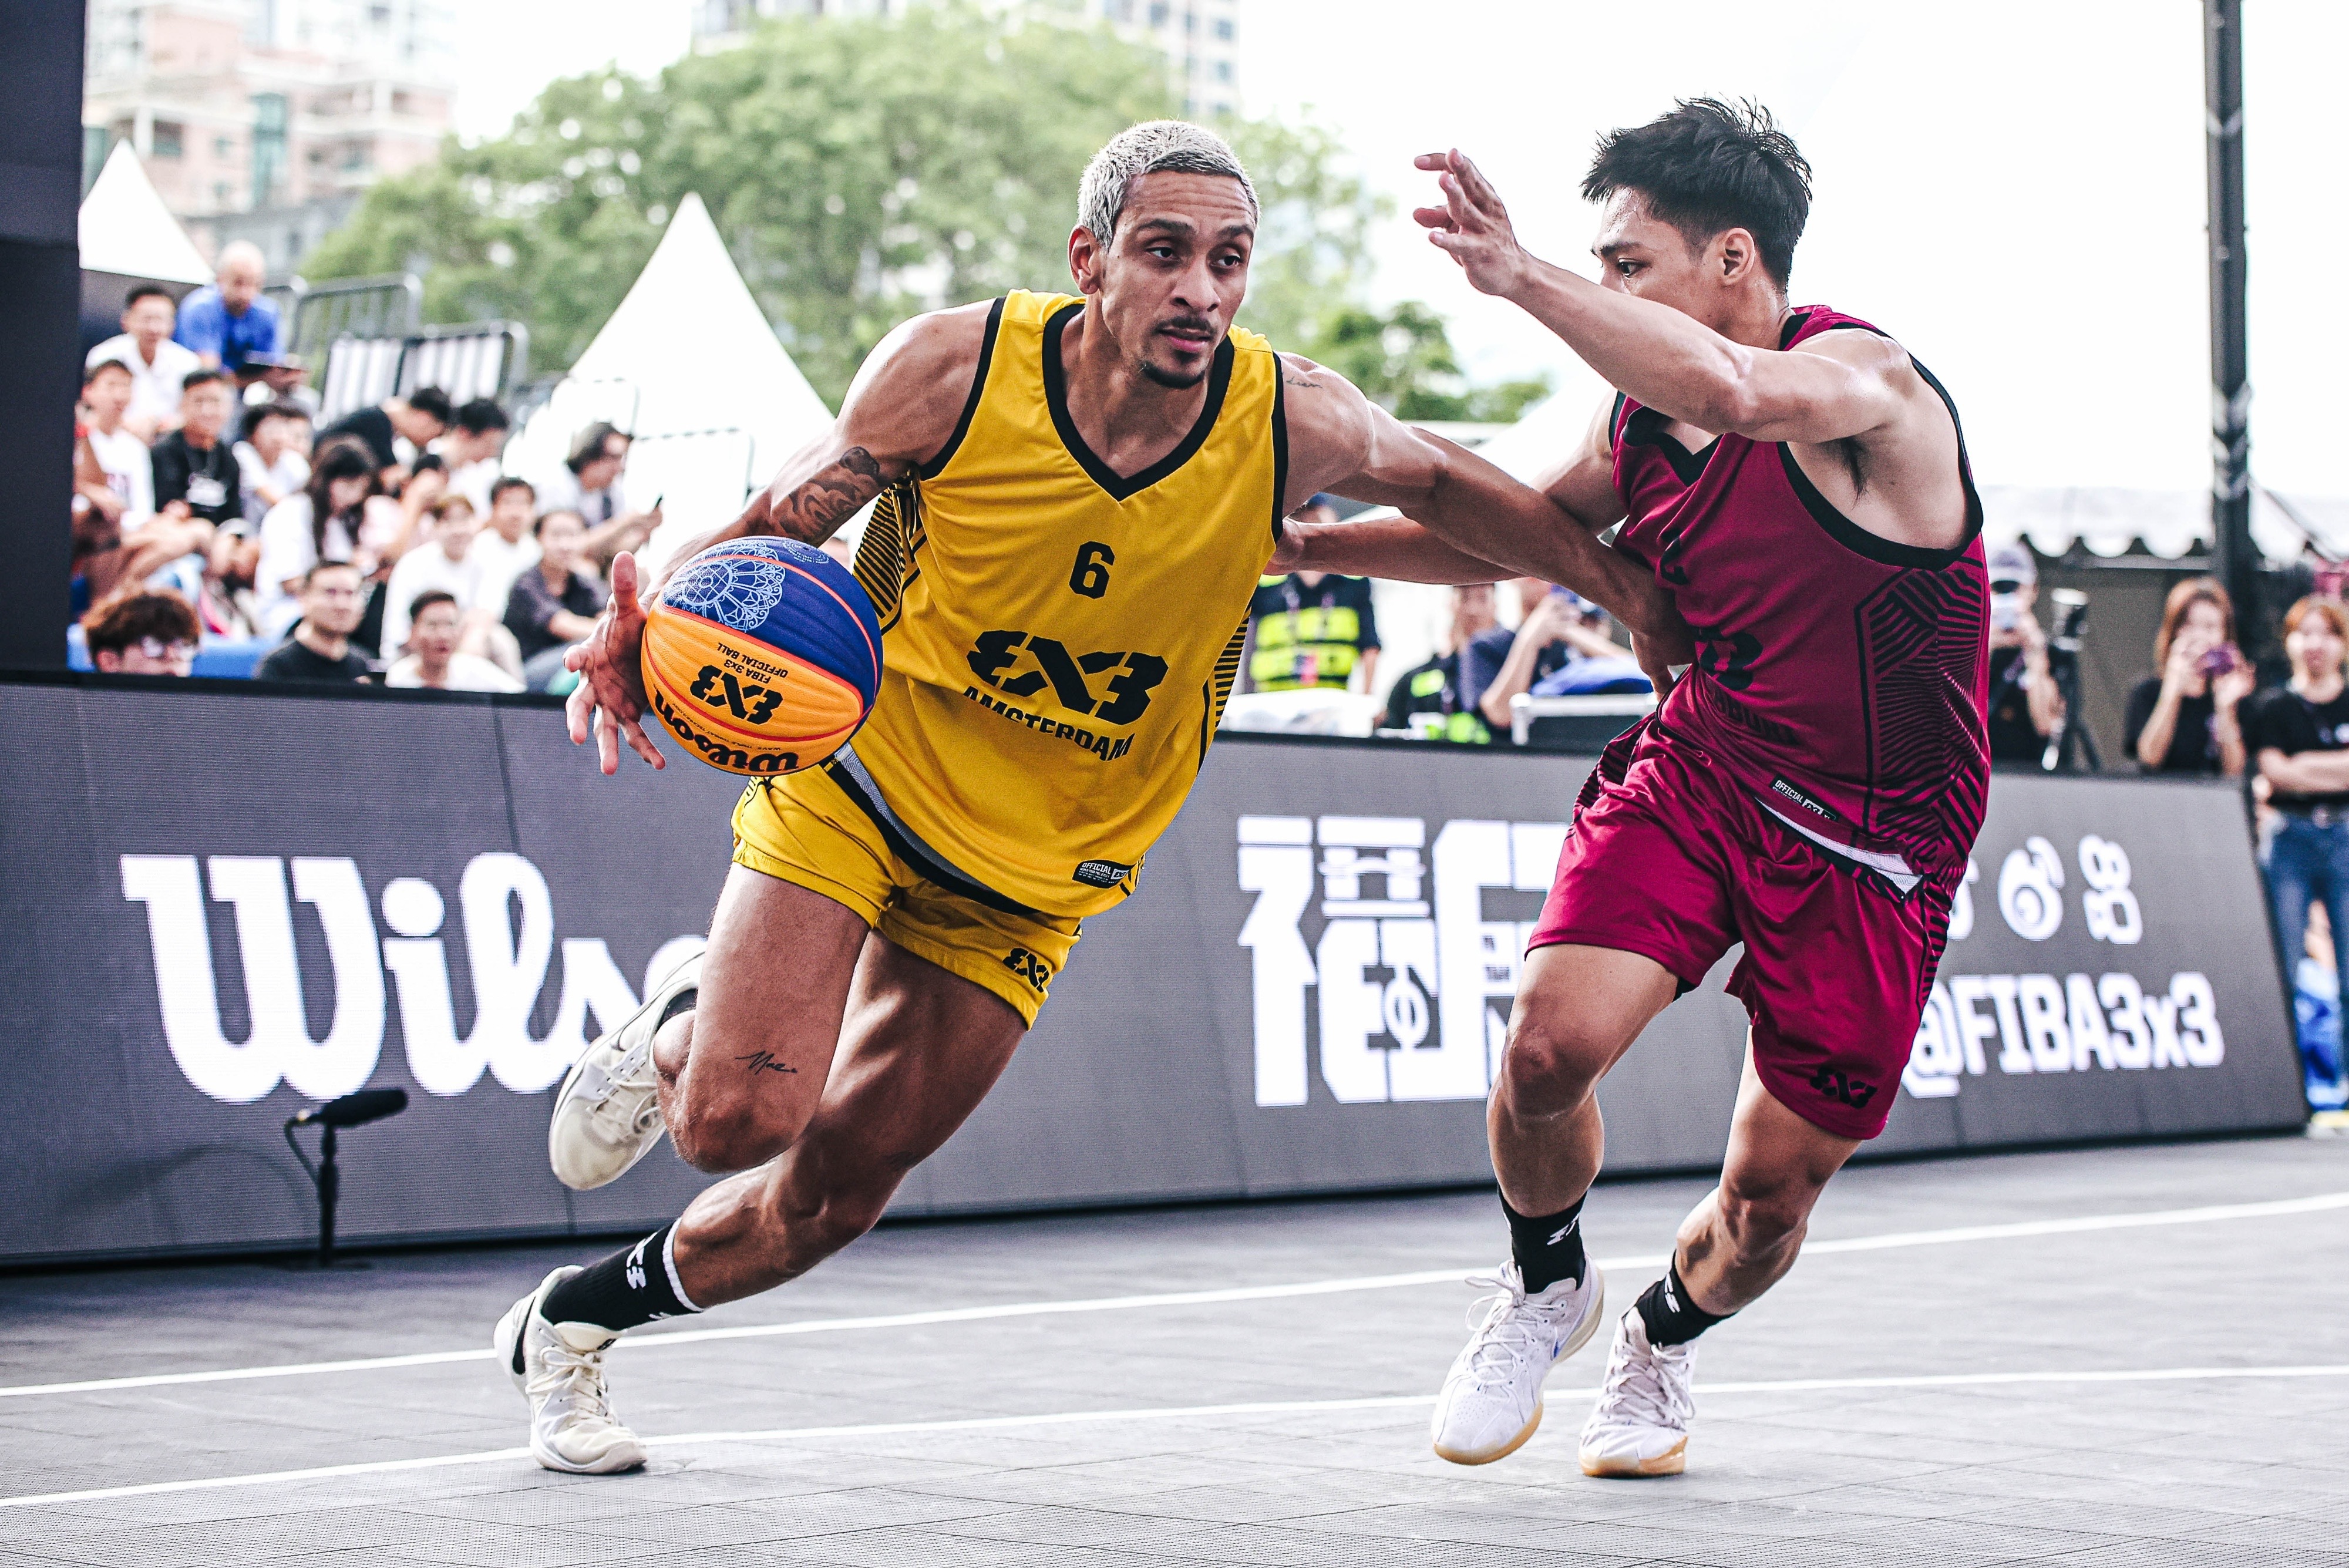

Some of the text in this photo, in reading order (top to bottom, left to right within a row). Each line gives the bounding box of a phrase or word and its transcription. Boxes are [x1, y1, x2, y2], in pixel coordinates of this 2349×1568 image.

[1069, 541, 1115, 599] 6
[717, 642, 788, 678] OFFICIAL BALL
[723, 659, 771, 684] FIBA 3x3
[963, 686, 1135, 761] AMSTERDAM
[1775, 780, 1803, 803] OFFICIAL
[1082, 863, 1111, 874] OFFICIAL
